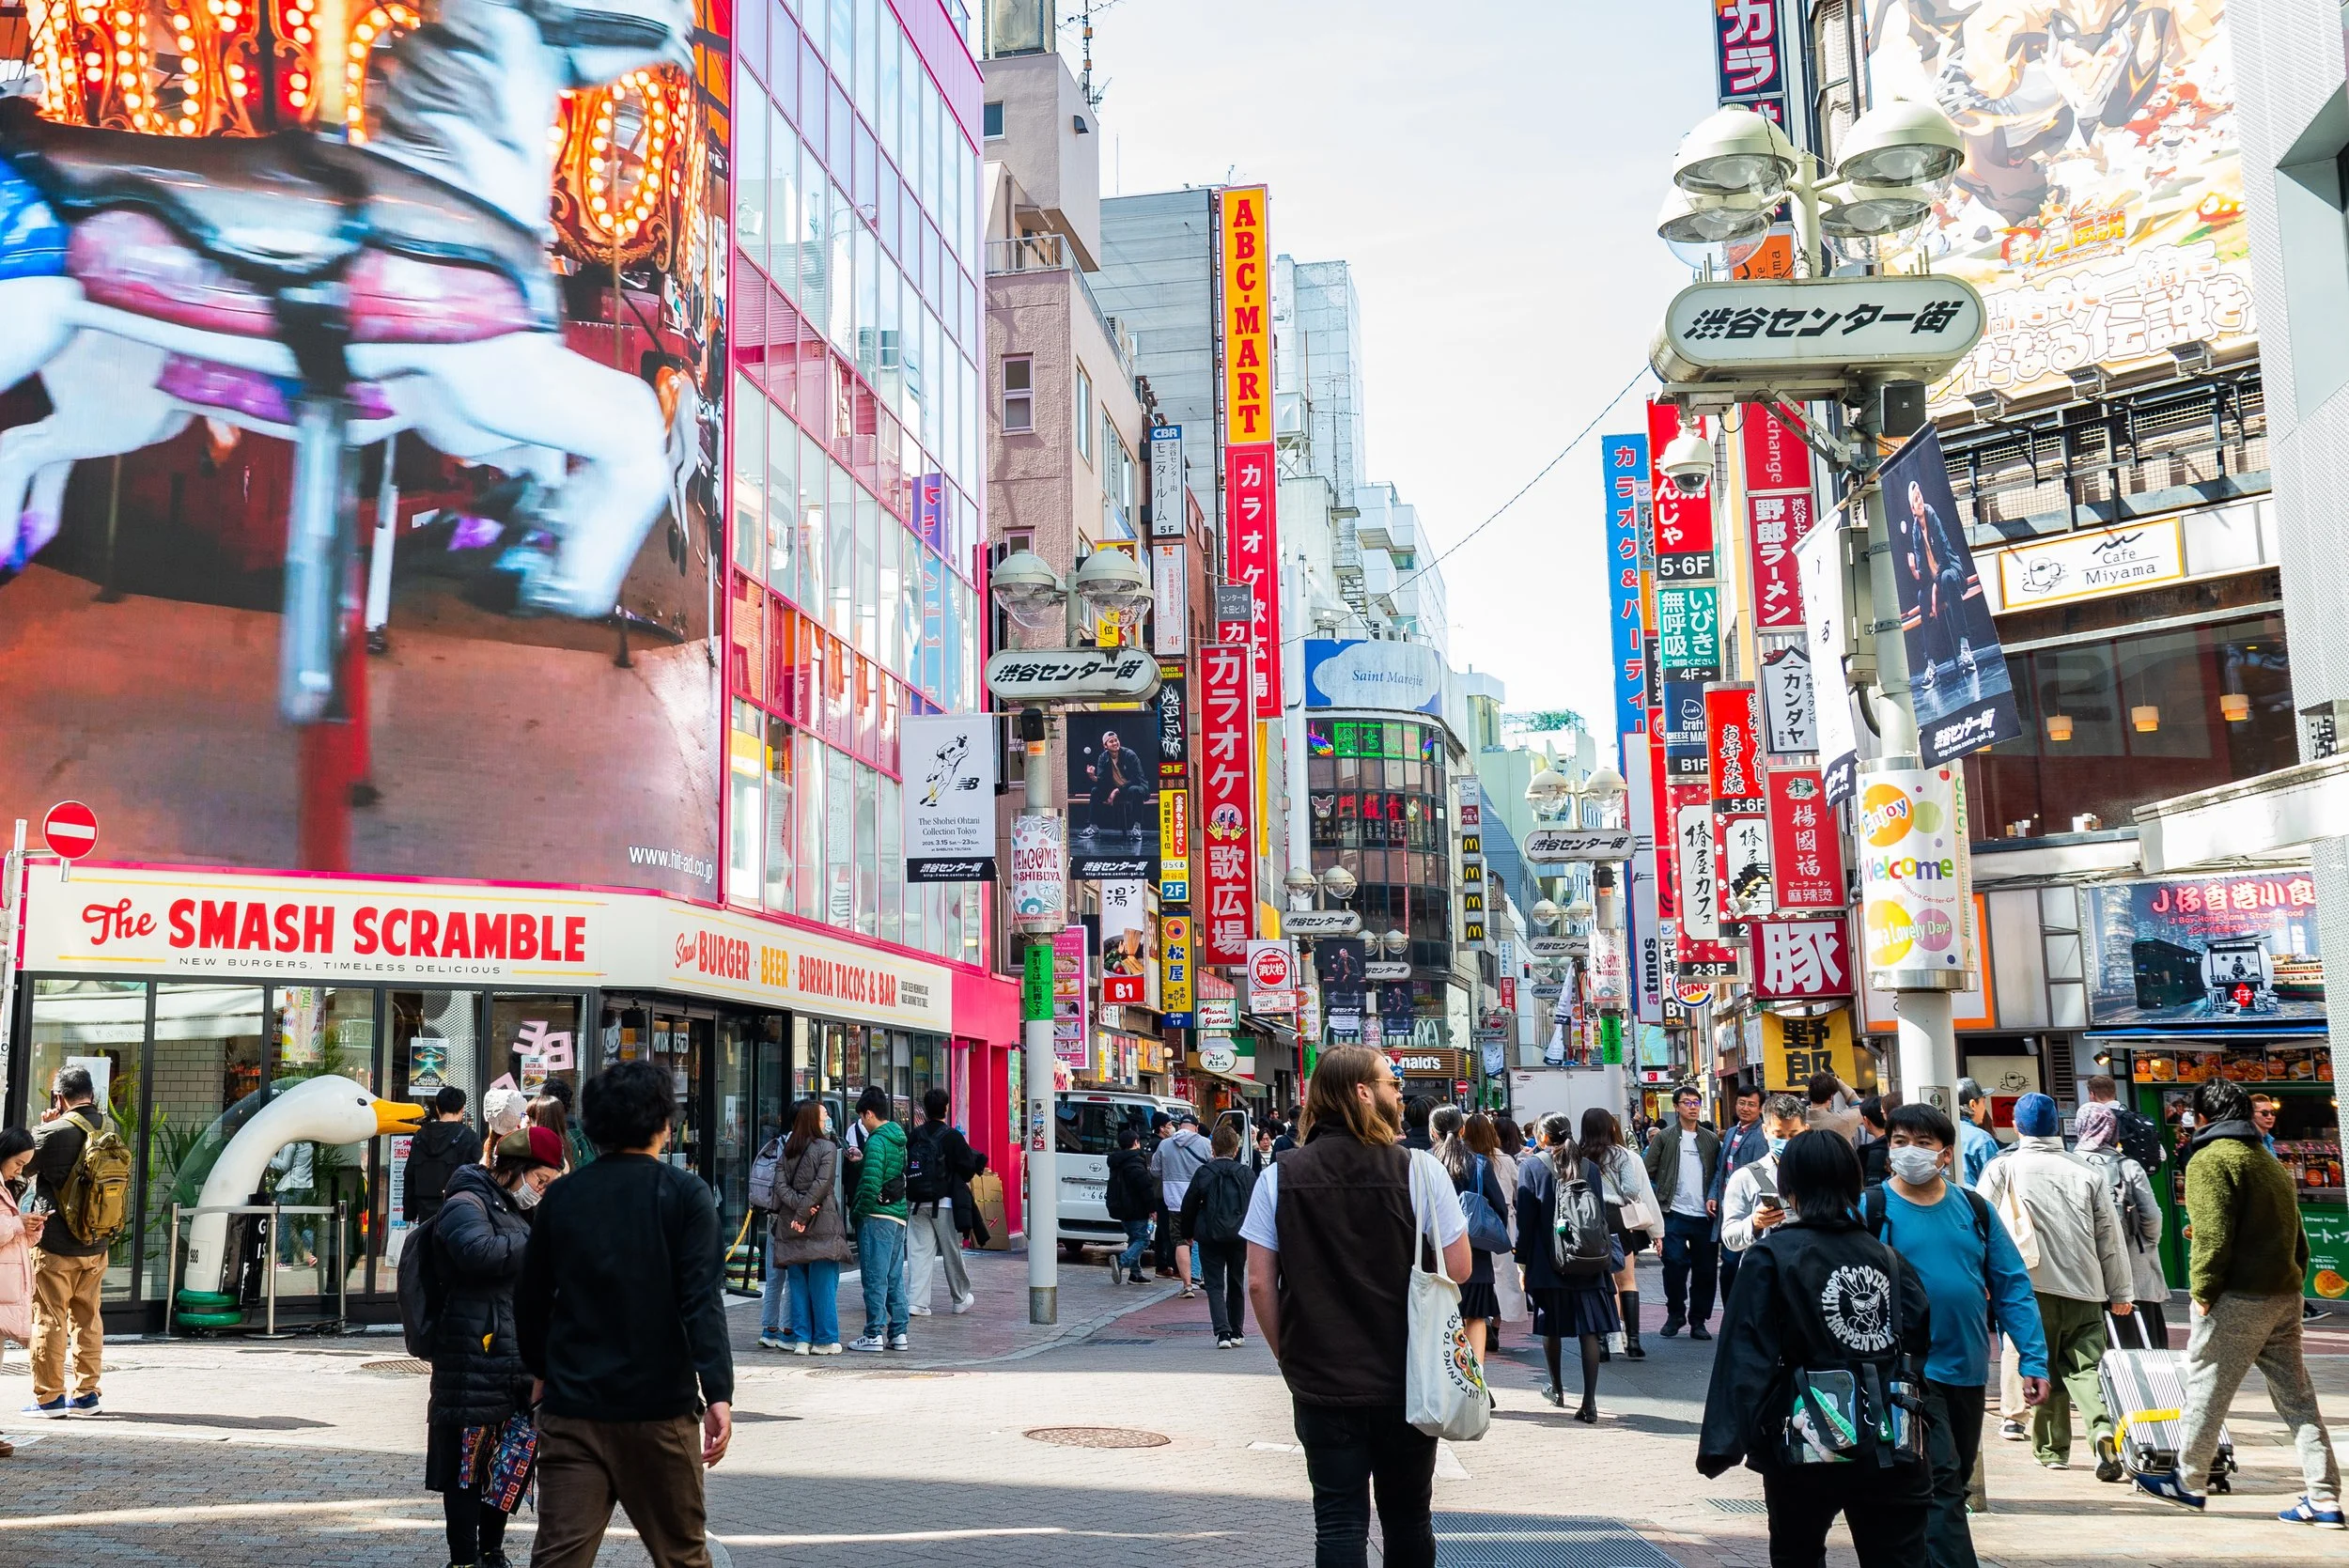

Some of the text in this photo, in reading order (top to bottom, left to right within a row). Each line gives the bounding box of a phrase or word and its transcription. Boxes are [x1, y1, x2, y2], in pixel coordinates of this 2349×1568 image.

[1721, 0, 1781, 123] カラ
[1683, 301, 1965, 341] 渋谷センター街
[1153, 428, 1178, 439] CBR
[1766, 401, 1782, 483] xchange
[1169, 442, 1178, 492] 渋谷センター街
[1155, 442, 1168, 522] モニタールーム
[1159, 525, 1174, 534] 5F
[1754, 499, 1791, 624] 野郎ラーメン
[2102, 549, 2136, 565] Cafe
[2086, 562, 2156, 586] Miyama
[1222, 605, 1246, 613] 太田ビル
[1662, 591, 1688, 658] 無呼吸
[1689, 590, 1715, 656] いびき
[1168, 636, 1180, 645] 4F
[993, 660, 1143, 683] 渋谷センター街
[1665, 658, 1716, 667] ご相談ください
[1680, 668, 1700, 680] 4F
[1352, 669, 1423, 688] Saint Marejie
[1784, 674, 1804, 745] カンダヤ
[1207, 649, 1244, 799] カラオケ
[1666, 732, 1689, 740] CHEESE
[1682, 720, 1703, 731] Craft
[1933, 708, 1996, 751] 渋谷センター街
[1160, 765, 1184, 774] 3F
[1680, 758, 1708, 771] B1F
[1719, 724, 1746, 795] お好み焼
[932, 816, 956, 825] Shohei
[957, 816, 980, 825] Ohtani
[1174, 795, 1184, 855] 全身もみほぐし
[1860, 797, 1907, 838] Enjoy
[957, 827, 977, 836] Tokyo
[1791, 804, 1822, 877] 楊國福
[1531, 837, 1628, 851] 渋谷センター街
[629, 846, 714, 884] www.hit-ad.co.jp
[920, 862, 984, 873] 渋谷センター街
[1019, 872, 1061, 882] SHIBUYA
[1082, 861, 1148, 873] 渋谷センター街
[1684, 820, 1715, 924] 椿屋カフェ
[1862, 857, 1953, 882] Welcome
[1164, 884, 1184, 897] 2F
[1206, 845, 1248, 955] 歌広場
[82, 897, 586, 962] The SMASH SCRAMBLE
[1285, 916, 1356, 926] 渋谷センター街
[1890, 923, 1925, 944] Lovely
[1926, 920, 1951, 936] Day!
[179, 957, 501, 974] NEW BURGERS, TIMELESS DELICIOUS
[699, 930, 750, 981] BURGER
[760, 945, 789, 987] BEER
[799, 955, 833, 997] BIRRIA
[834, 964, 866, 1002] TACOS
[868, 972, 876, 1004] &
[879, 971, 896, 1008] BAR
[1166, 947, 1186, 983] 松屋
[1258, 963, 1285, 976] 消火栓
[1365, 966, 1408, 974] 谷センター街
[1763, 922, 1843, 994] 豚
[1032, 950, 1043, 1016] 客引きは犯罪です
[1644, 938, 1660, 1005] atmos
[1114, 983, 1134, 998] B1
[1678, 983, 1709, 999] KING
[1781, 1017, 1836, 1090] 野郎
[1822, 1270, 1843, 1304] HOPE
[1841, 1265, 1874, 1283] GOOD
[1443, 1333, 1451, 1346] TO
[1825, 1312, 1870, 1352] HAPPEN
[1443, 1352, 1480, 1400] LISTENING
